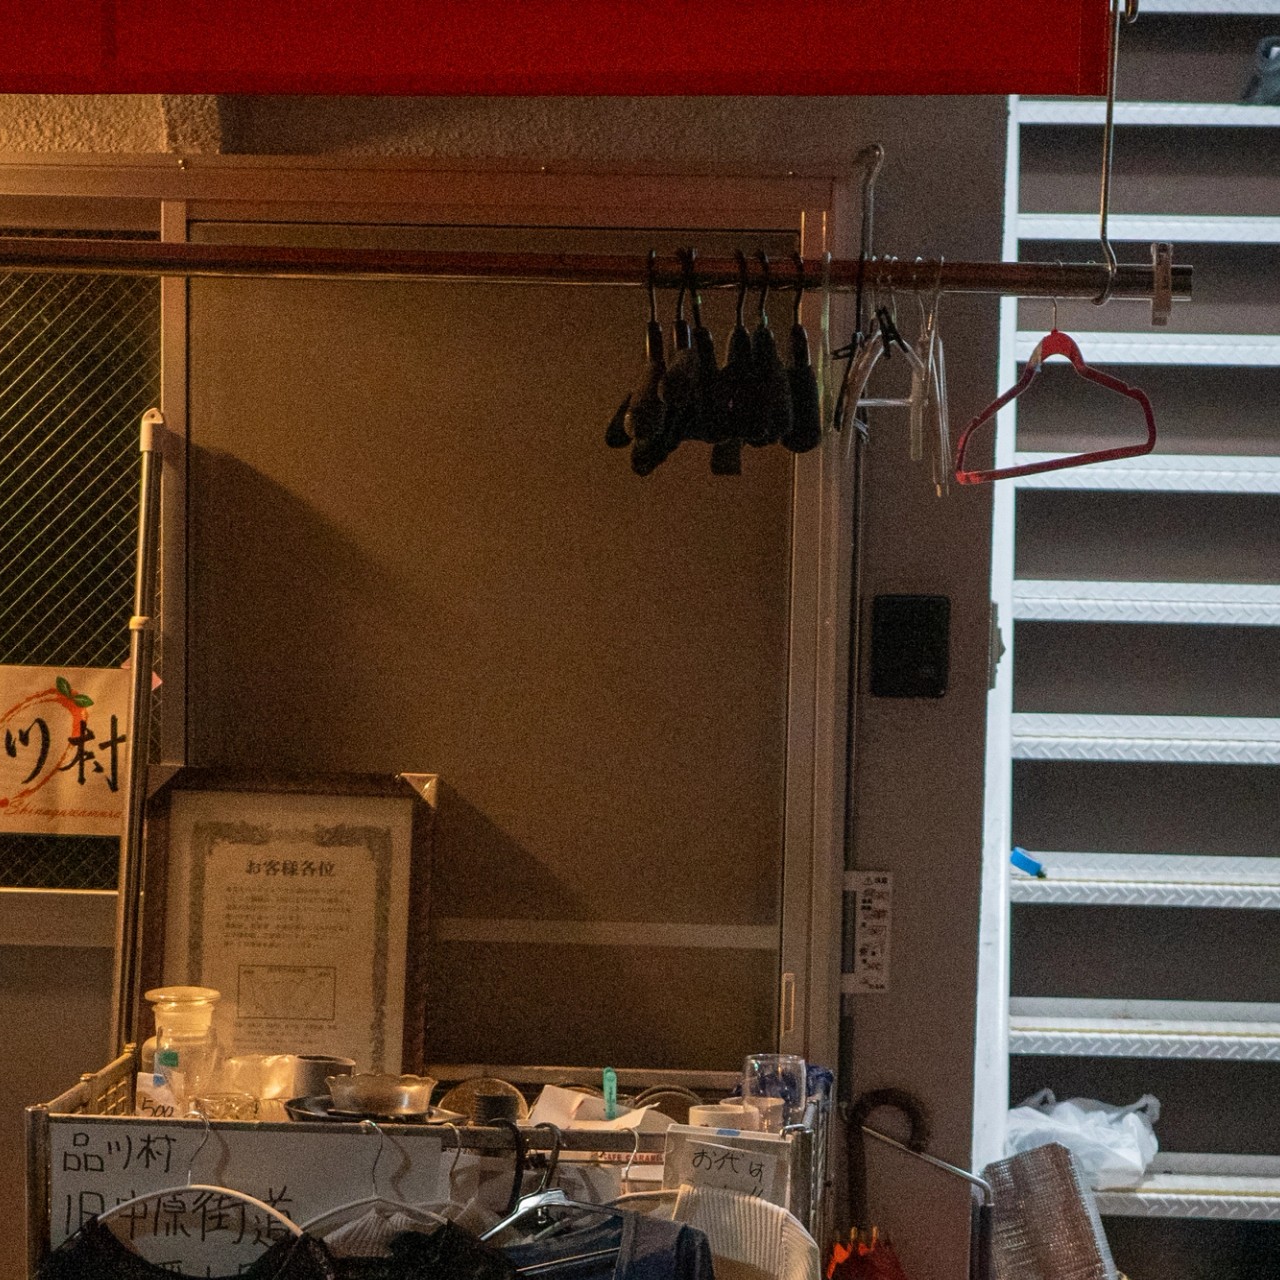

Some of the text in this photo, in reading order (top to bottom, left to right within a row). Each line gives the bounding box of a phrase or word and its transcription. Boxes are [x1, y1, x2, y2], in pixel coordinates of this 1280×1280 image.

[141, 1097, 174, 1118] 500
[63, 1132, 177, 1173] 品川村
